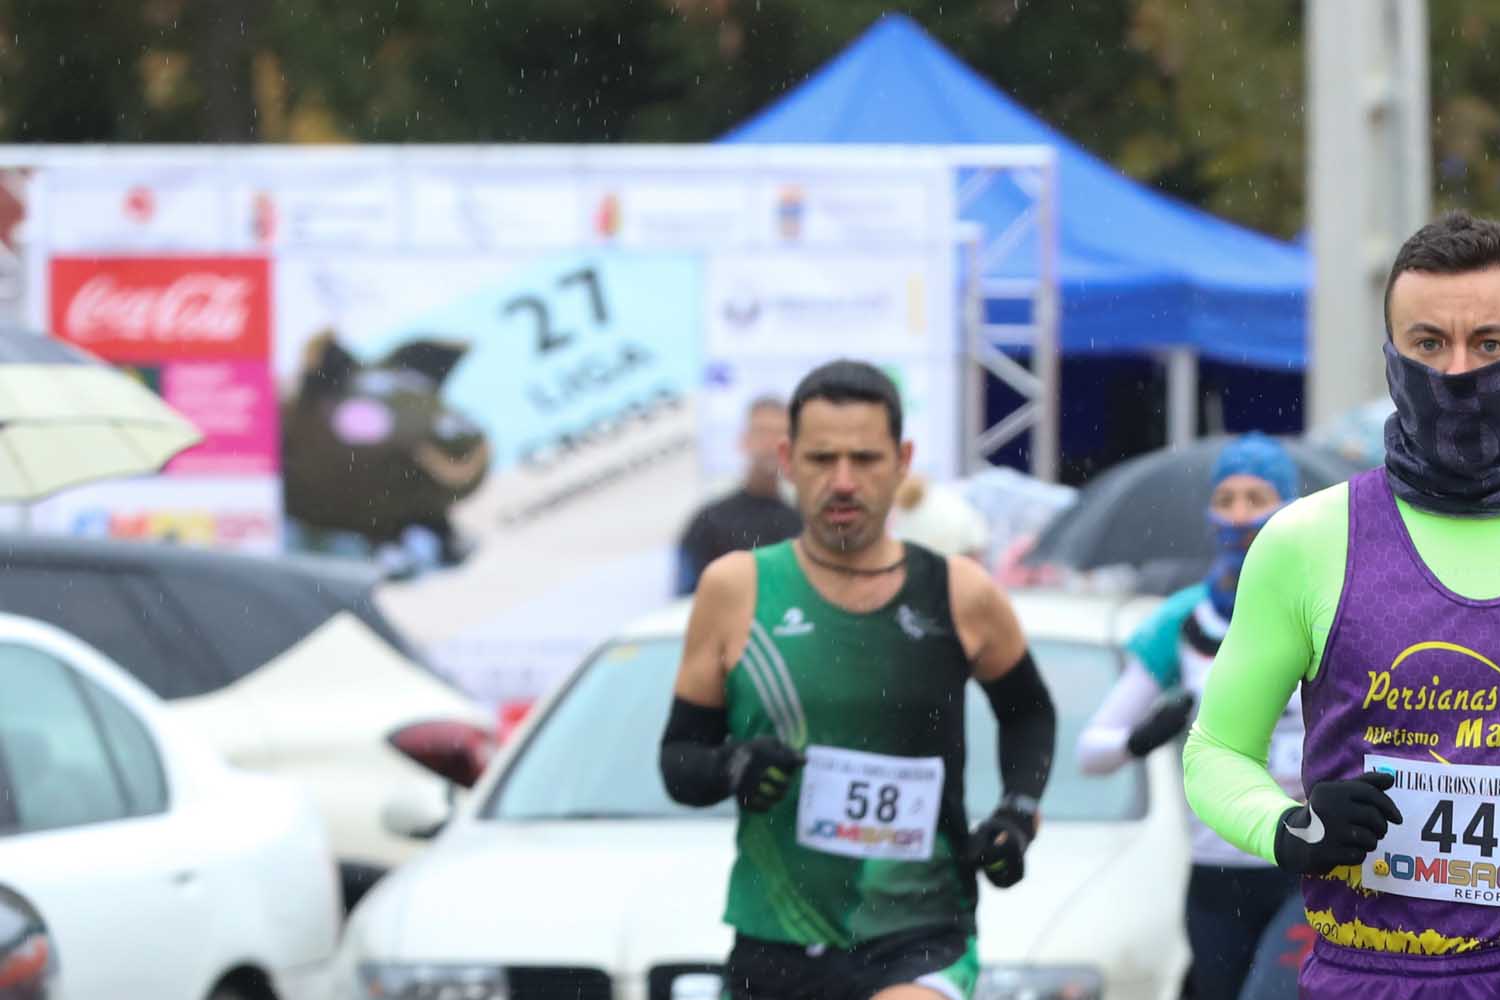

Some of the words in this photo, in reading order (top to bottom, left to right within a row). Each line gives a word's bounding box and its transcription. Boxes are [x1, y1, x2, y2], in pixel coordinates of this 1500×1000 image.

[501, 268, 607, 354] 27
[1362, 670, 1498, 711] Persianas
[1363, 726, 1440, 746] Atletismo
[845, 780, 900, 823] 58
[1407, 771, 1434, 793] LIGA
[1438, 775, 1477, 796] CROSS
[1421, 799, 1499, 858] 44
